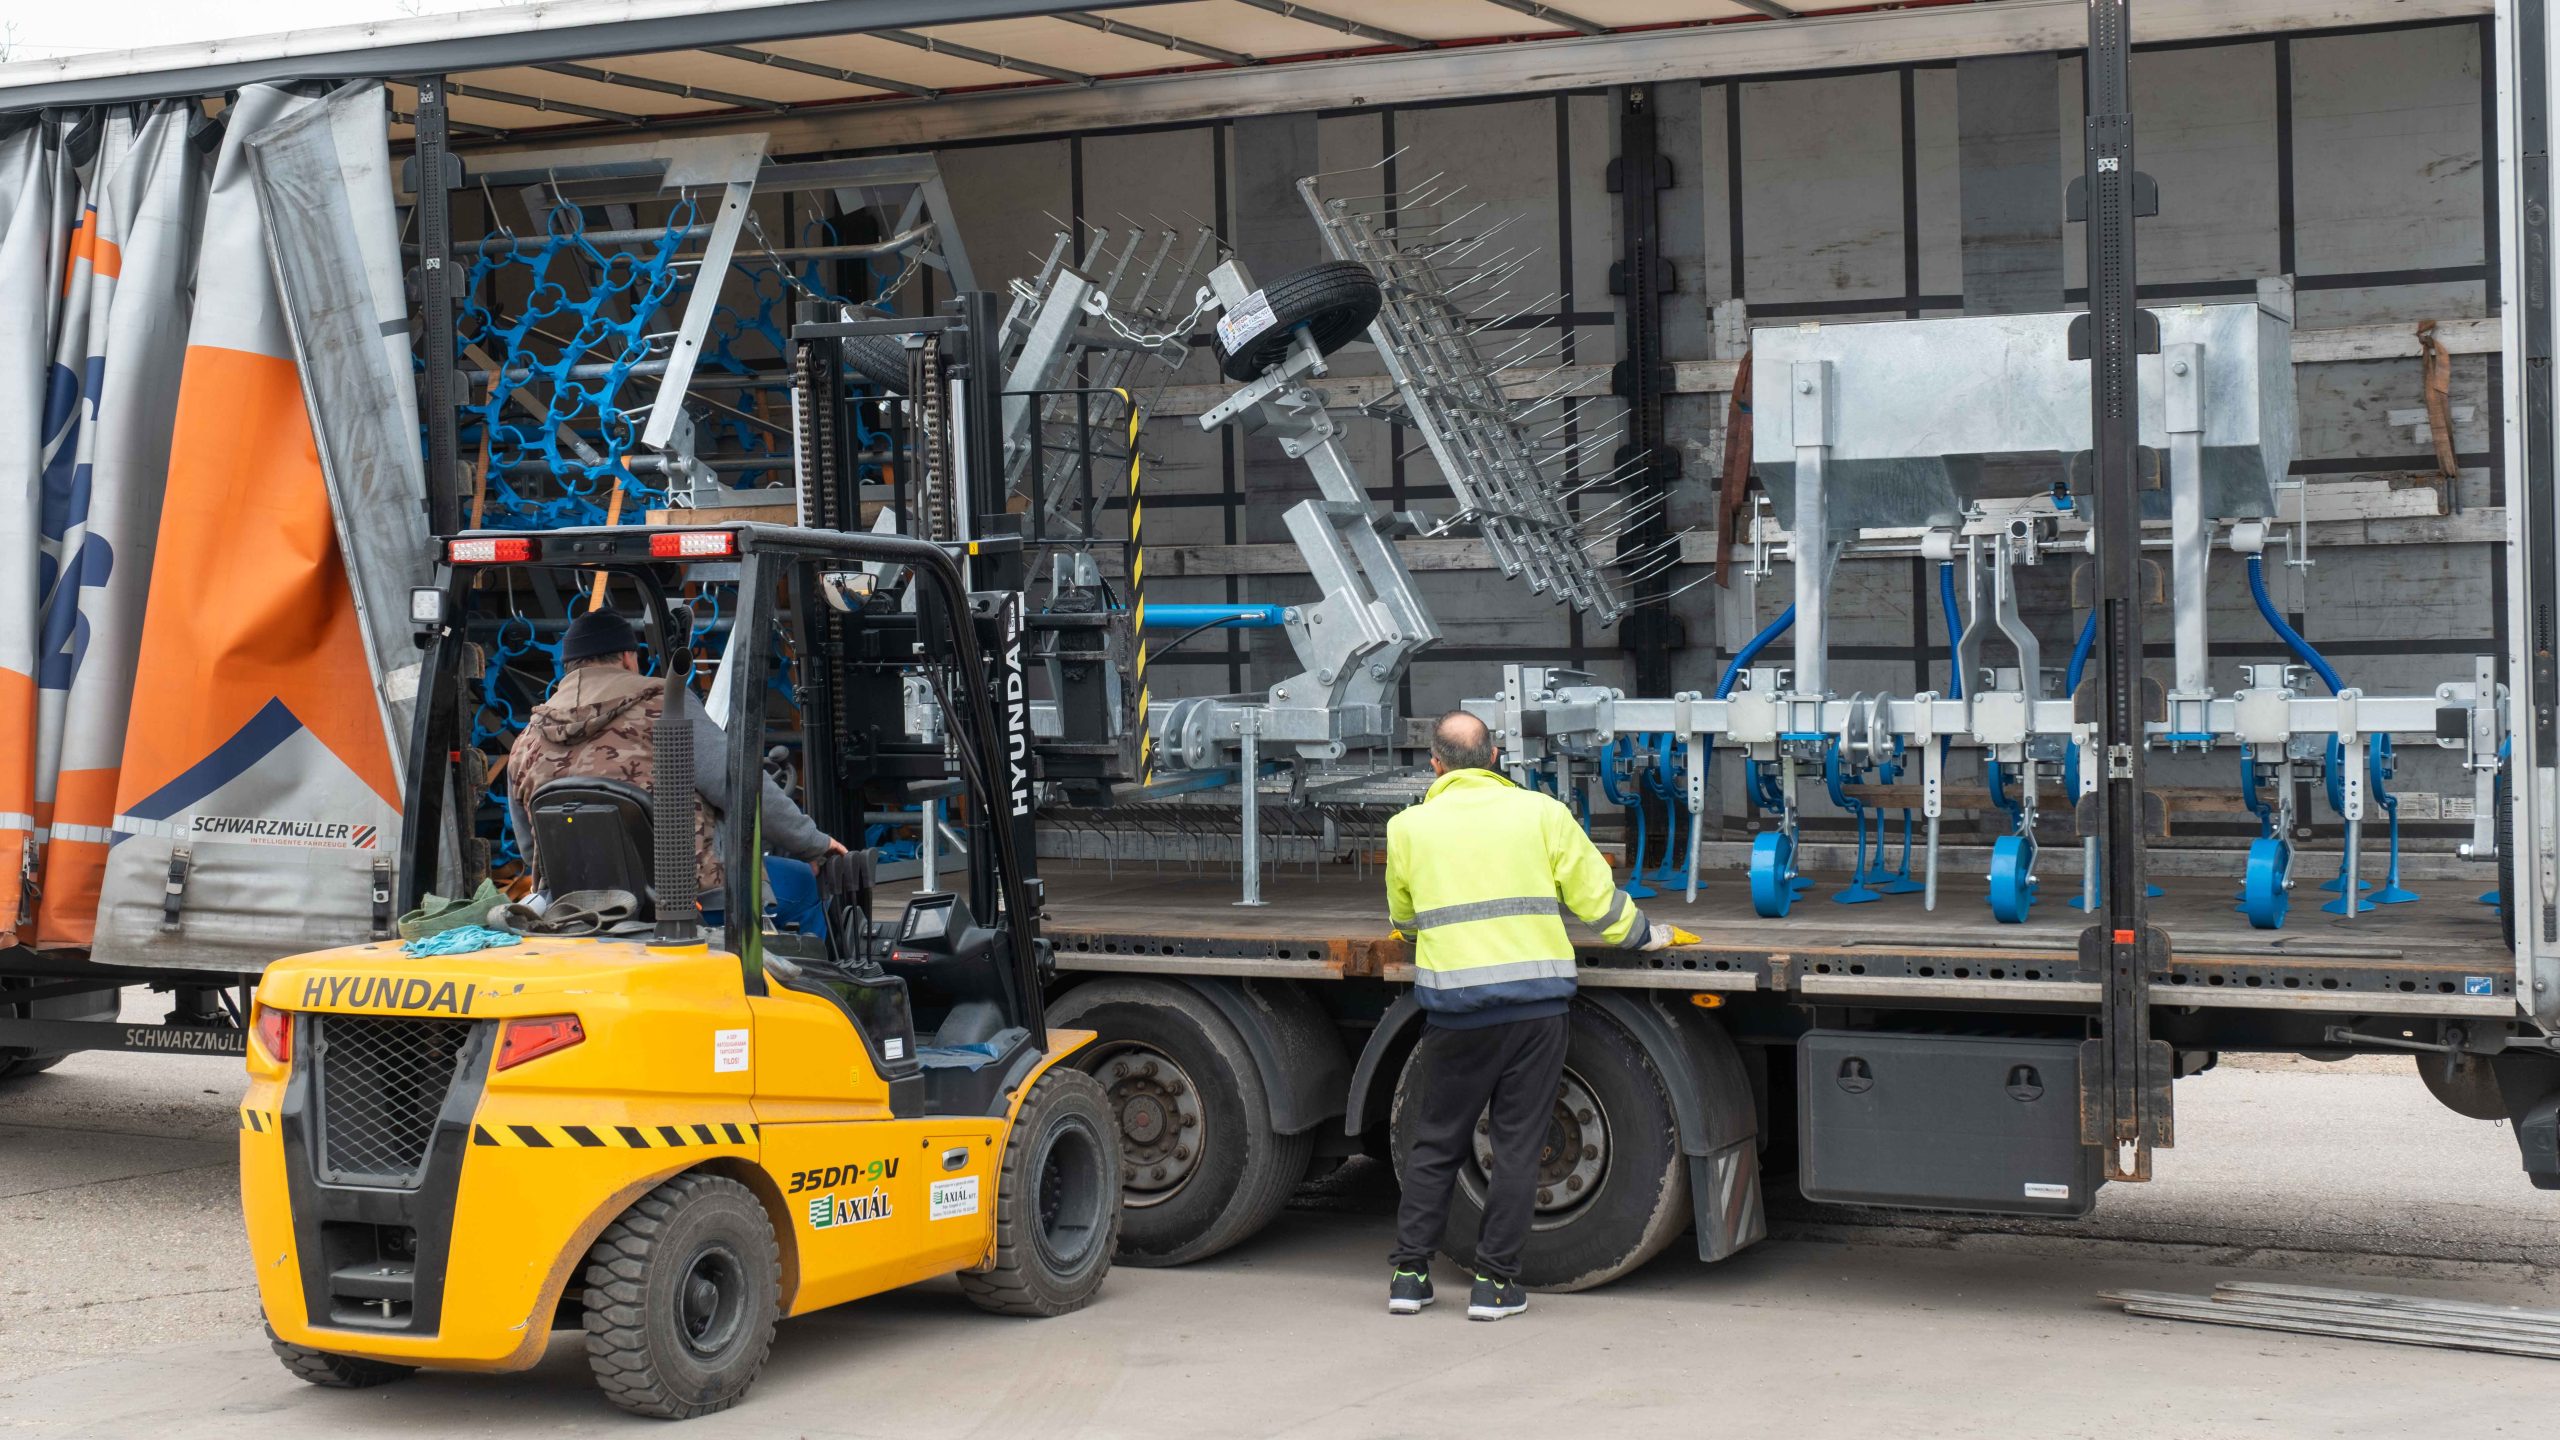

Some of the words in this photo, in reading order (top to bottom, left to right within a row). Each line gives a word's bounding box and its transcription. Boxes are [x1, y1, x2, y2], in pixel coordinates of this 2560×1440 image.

[250, 837, 302, 846] INTELLIGENTE
[303, 840, 347, 849] FAHRZEUGE
[302, 976, 476, 1015] HYUNDAI
[125, 1028, 246, 1052] SCHWARZMÜLL
[835, 1186, 892, 1226] AXIÁL
[943, 1186, 968, 1204] AXIÁL
